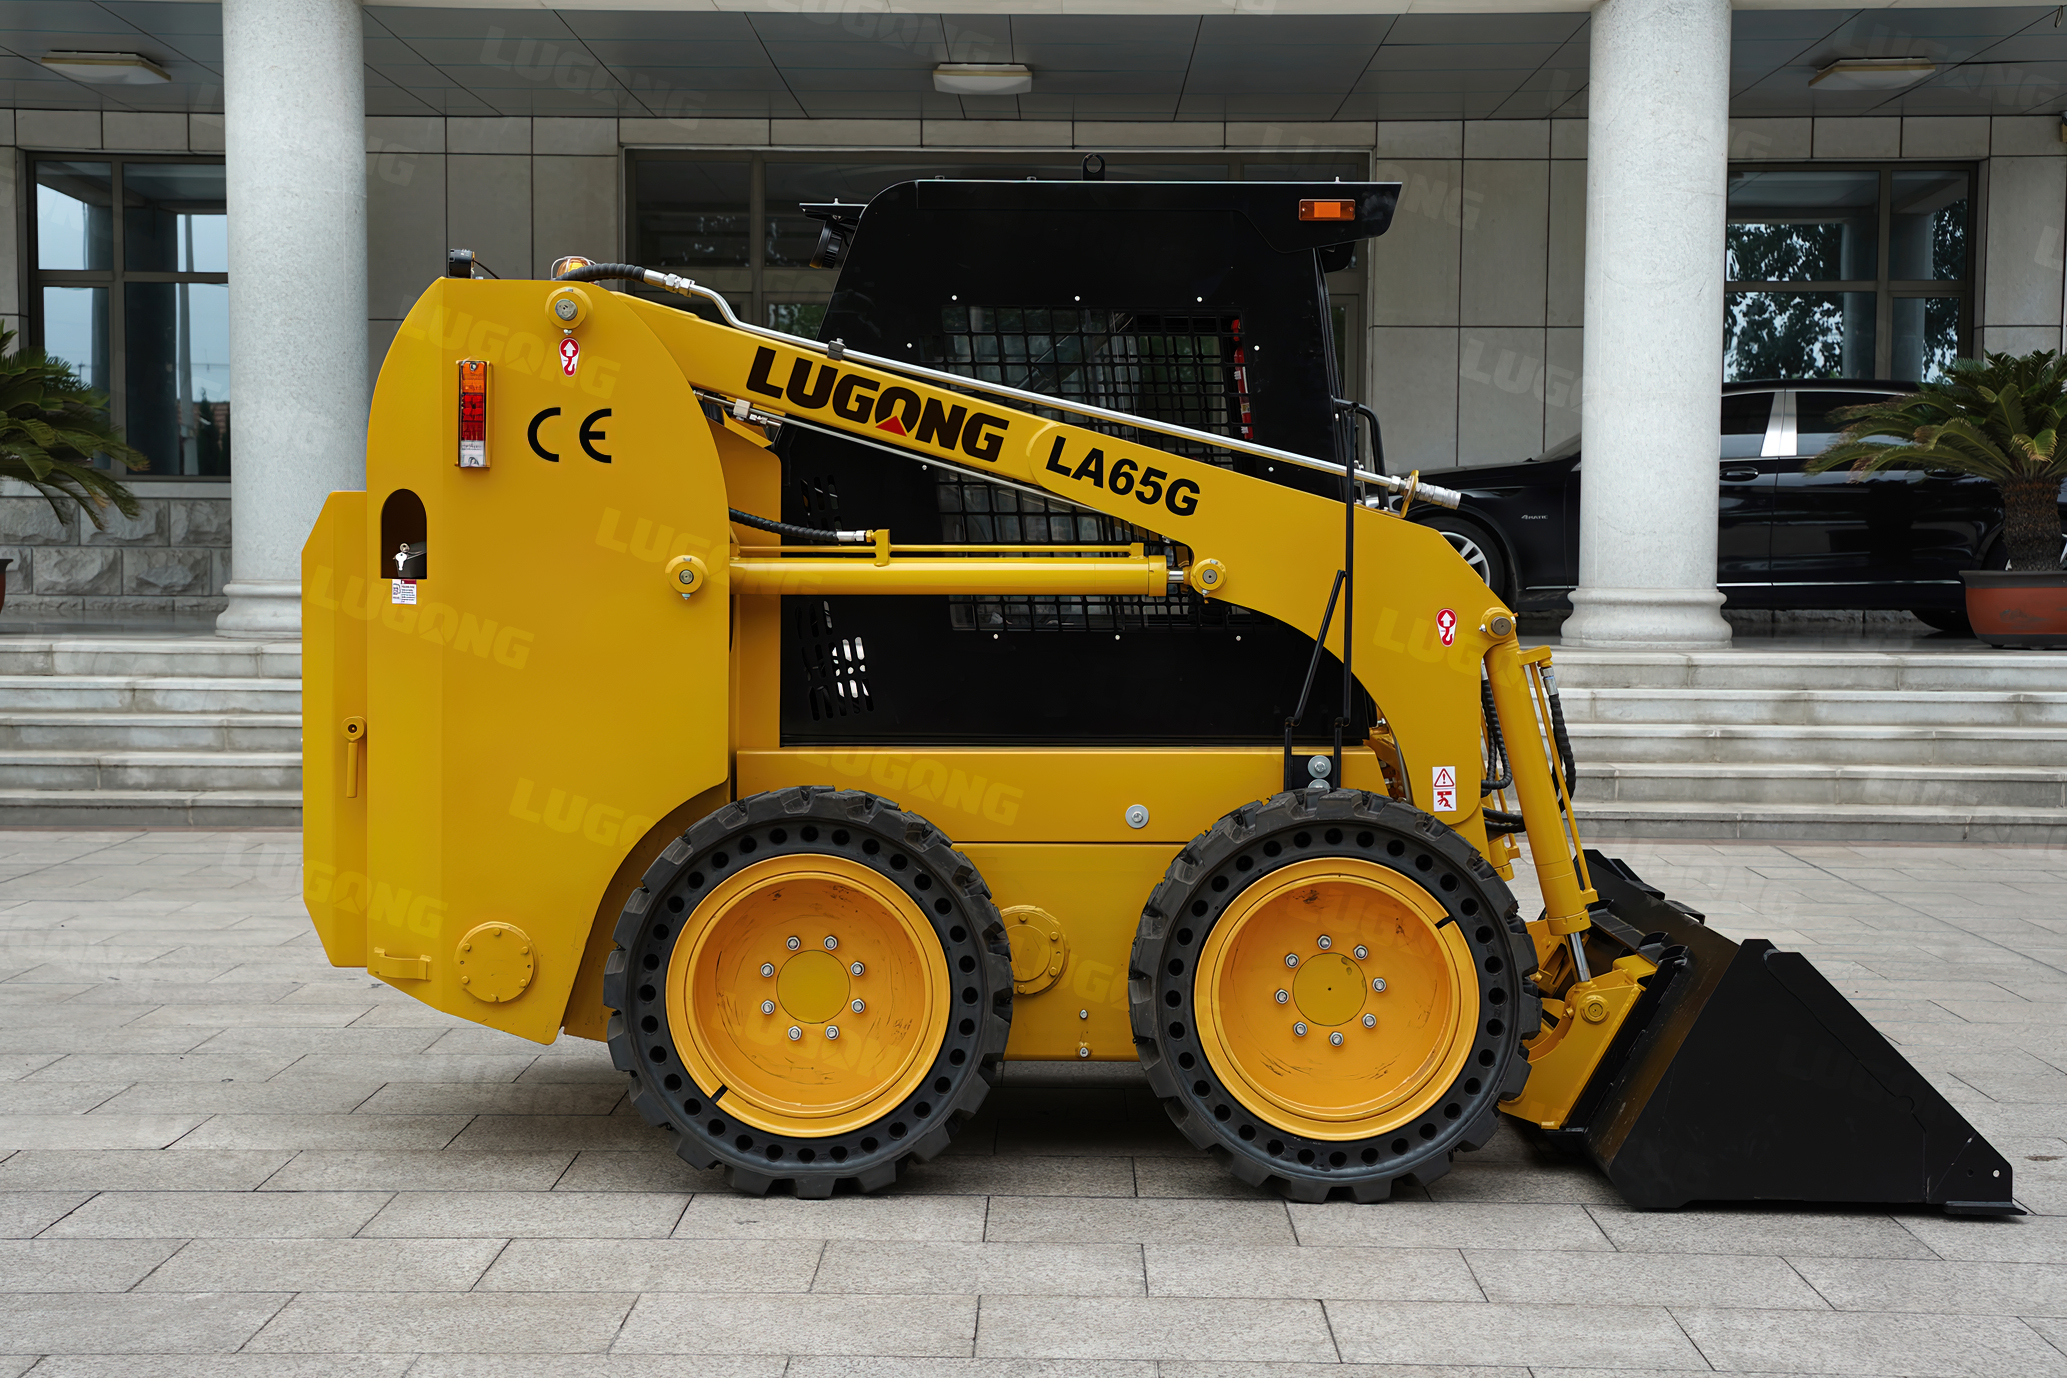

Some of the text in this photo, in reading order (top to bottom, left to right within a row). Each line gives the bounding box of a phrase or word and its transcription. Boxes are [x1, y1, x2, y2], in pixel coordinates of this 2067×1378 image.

[527, 407, 612, 464] CE
[746, 346, 1200, 516] LUGONG LA65G
